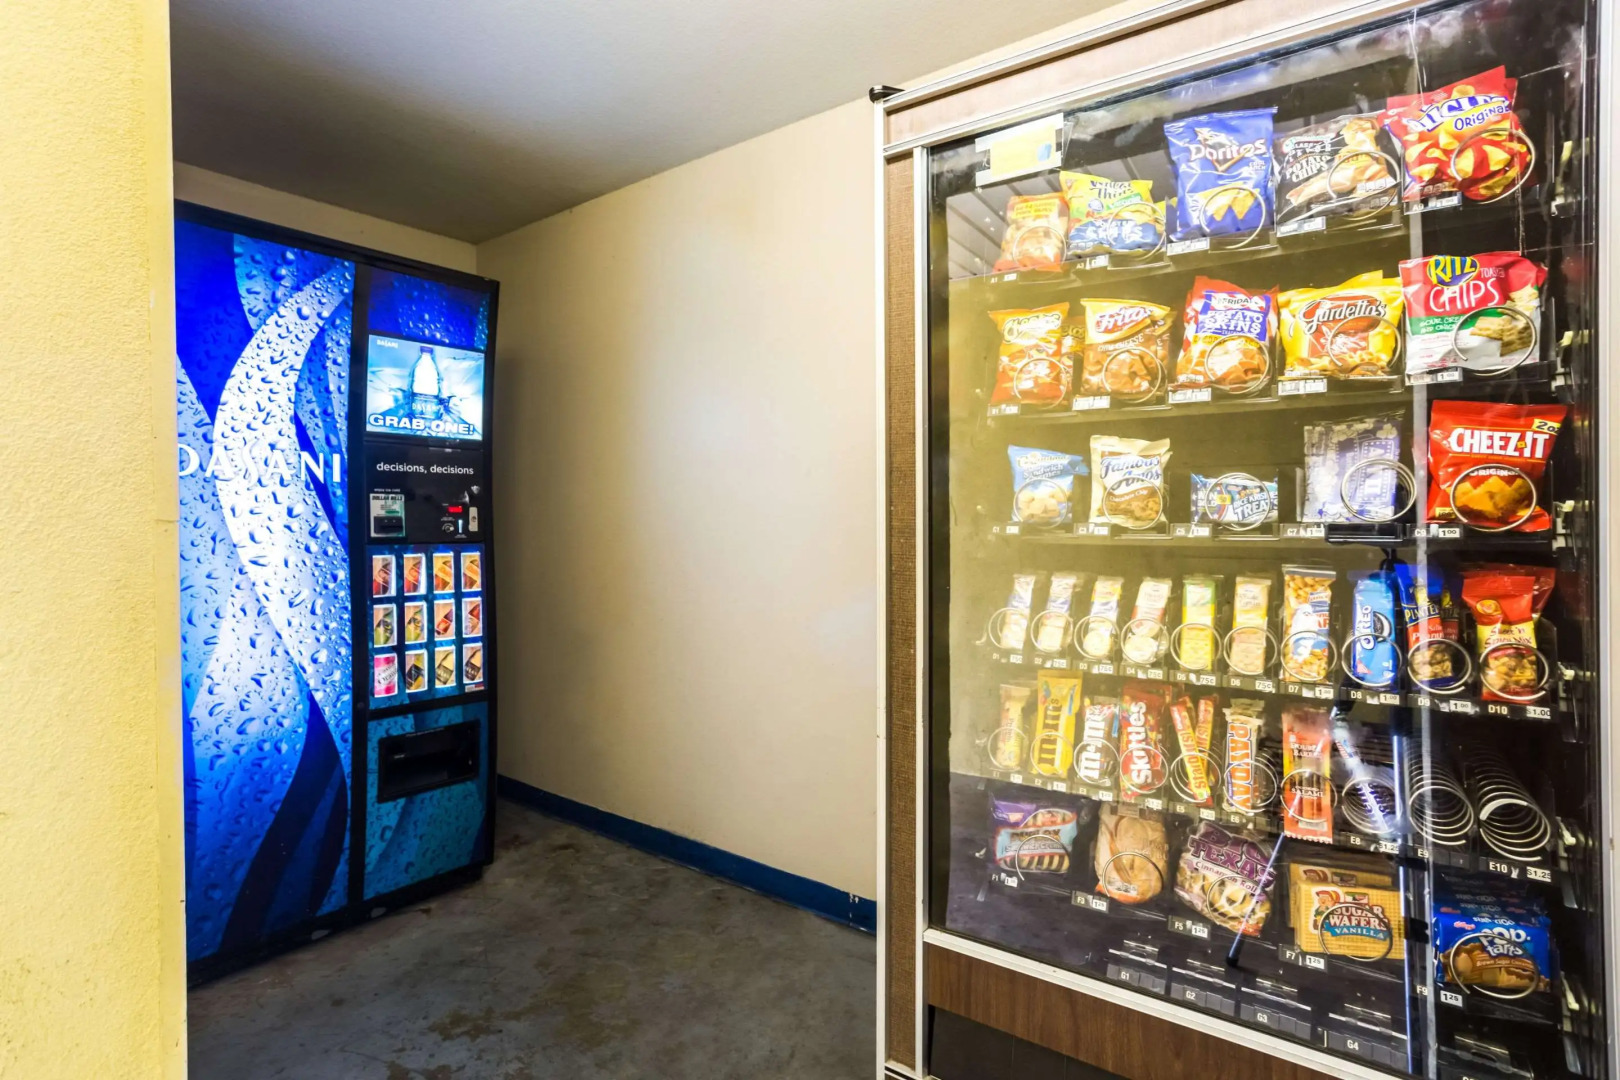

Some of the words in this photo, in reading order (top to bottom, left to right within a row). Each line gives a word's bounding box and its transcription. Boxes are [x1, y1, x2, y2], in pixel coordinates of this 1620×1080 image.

[1190, 138, 1266, 161] Doritos
[1428, 255, 1477, 284] RITZ
[1429, 278, 1500, 312] CHIPS
[1299, 300, 1387, 335] Gardetto's
[368, 414, 426, 431] GRAB
[430, 420, 475, 435] ONE!
[1535, 421, 1547, 431] 2
[178, 441, 341, 488] DASANI
[376, 462, 427, 474] decisions,
[429, 464, 474, 475] decisions
[1100, 457, 1160, 479] Famous
[1360, 605, 1376, 650] OREO
[1288, 684, 1298, 693] D7
[1350, 691, 1362, 699] D8
[1418, 697, 1430, 706] D9
[1488, 705, 1508, 714] D10
[1127, 701, 1153, 785] Skittles
[1229, 723, 1253, 811] PAYDAY
[1350, 836, 1361, 845] E8
[1418, 849, 1429, 858] E9
[1188, 835, 1276, 889] TEXAS
[992, 873, 999, 881] F1
[1489, 862, 1508, 873] E10
[1527, 868, 1551, 880] $1.25
[1240, 880, 1259, 894] Roll
[1077, 896, 1085, 904] F3
[1334, 904, 1384, 917] SUGAR
[1174, 922, 1183, 930] F5
[1329, 915, 1388, 931] WAFERS
[1334, 926, 1385, 939] VANILLA
[1286, 951, 1296, 960] F7
[1121, 971, 1130, 981] G1
[1186, 990, 1195, 1000] G2
[1416, 985, 1428, 995] F9
[1257, 1013, 1268, 1023] G3
[1347, 1039, 1359, 1051] G4
